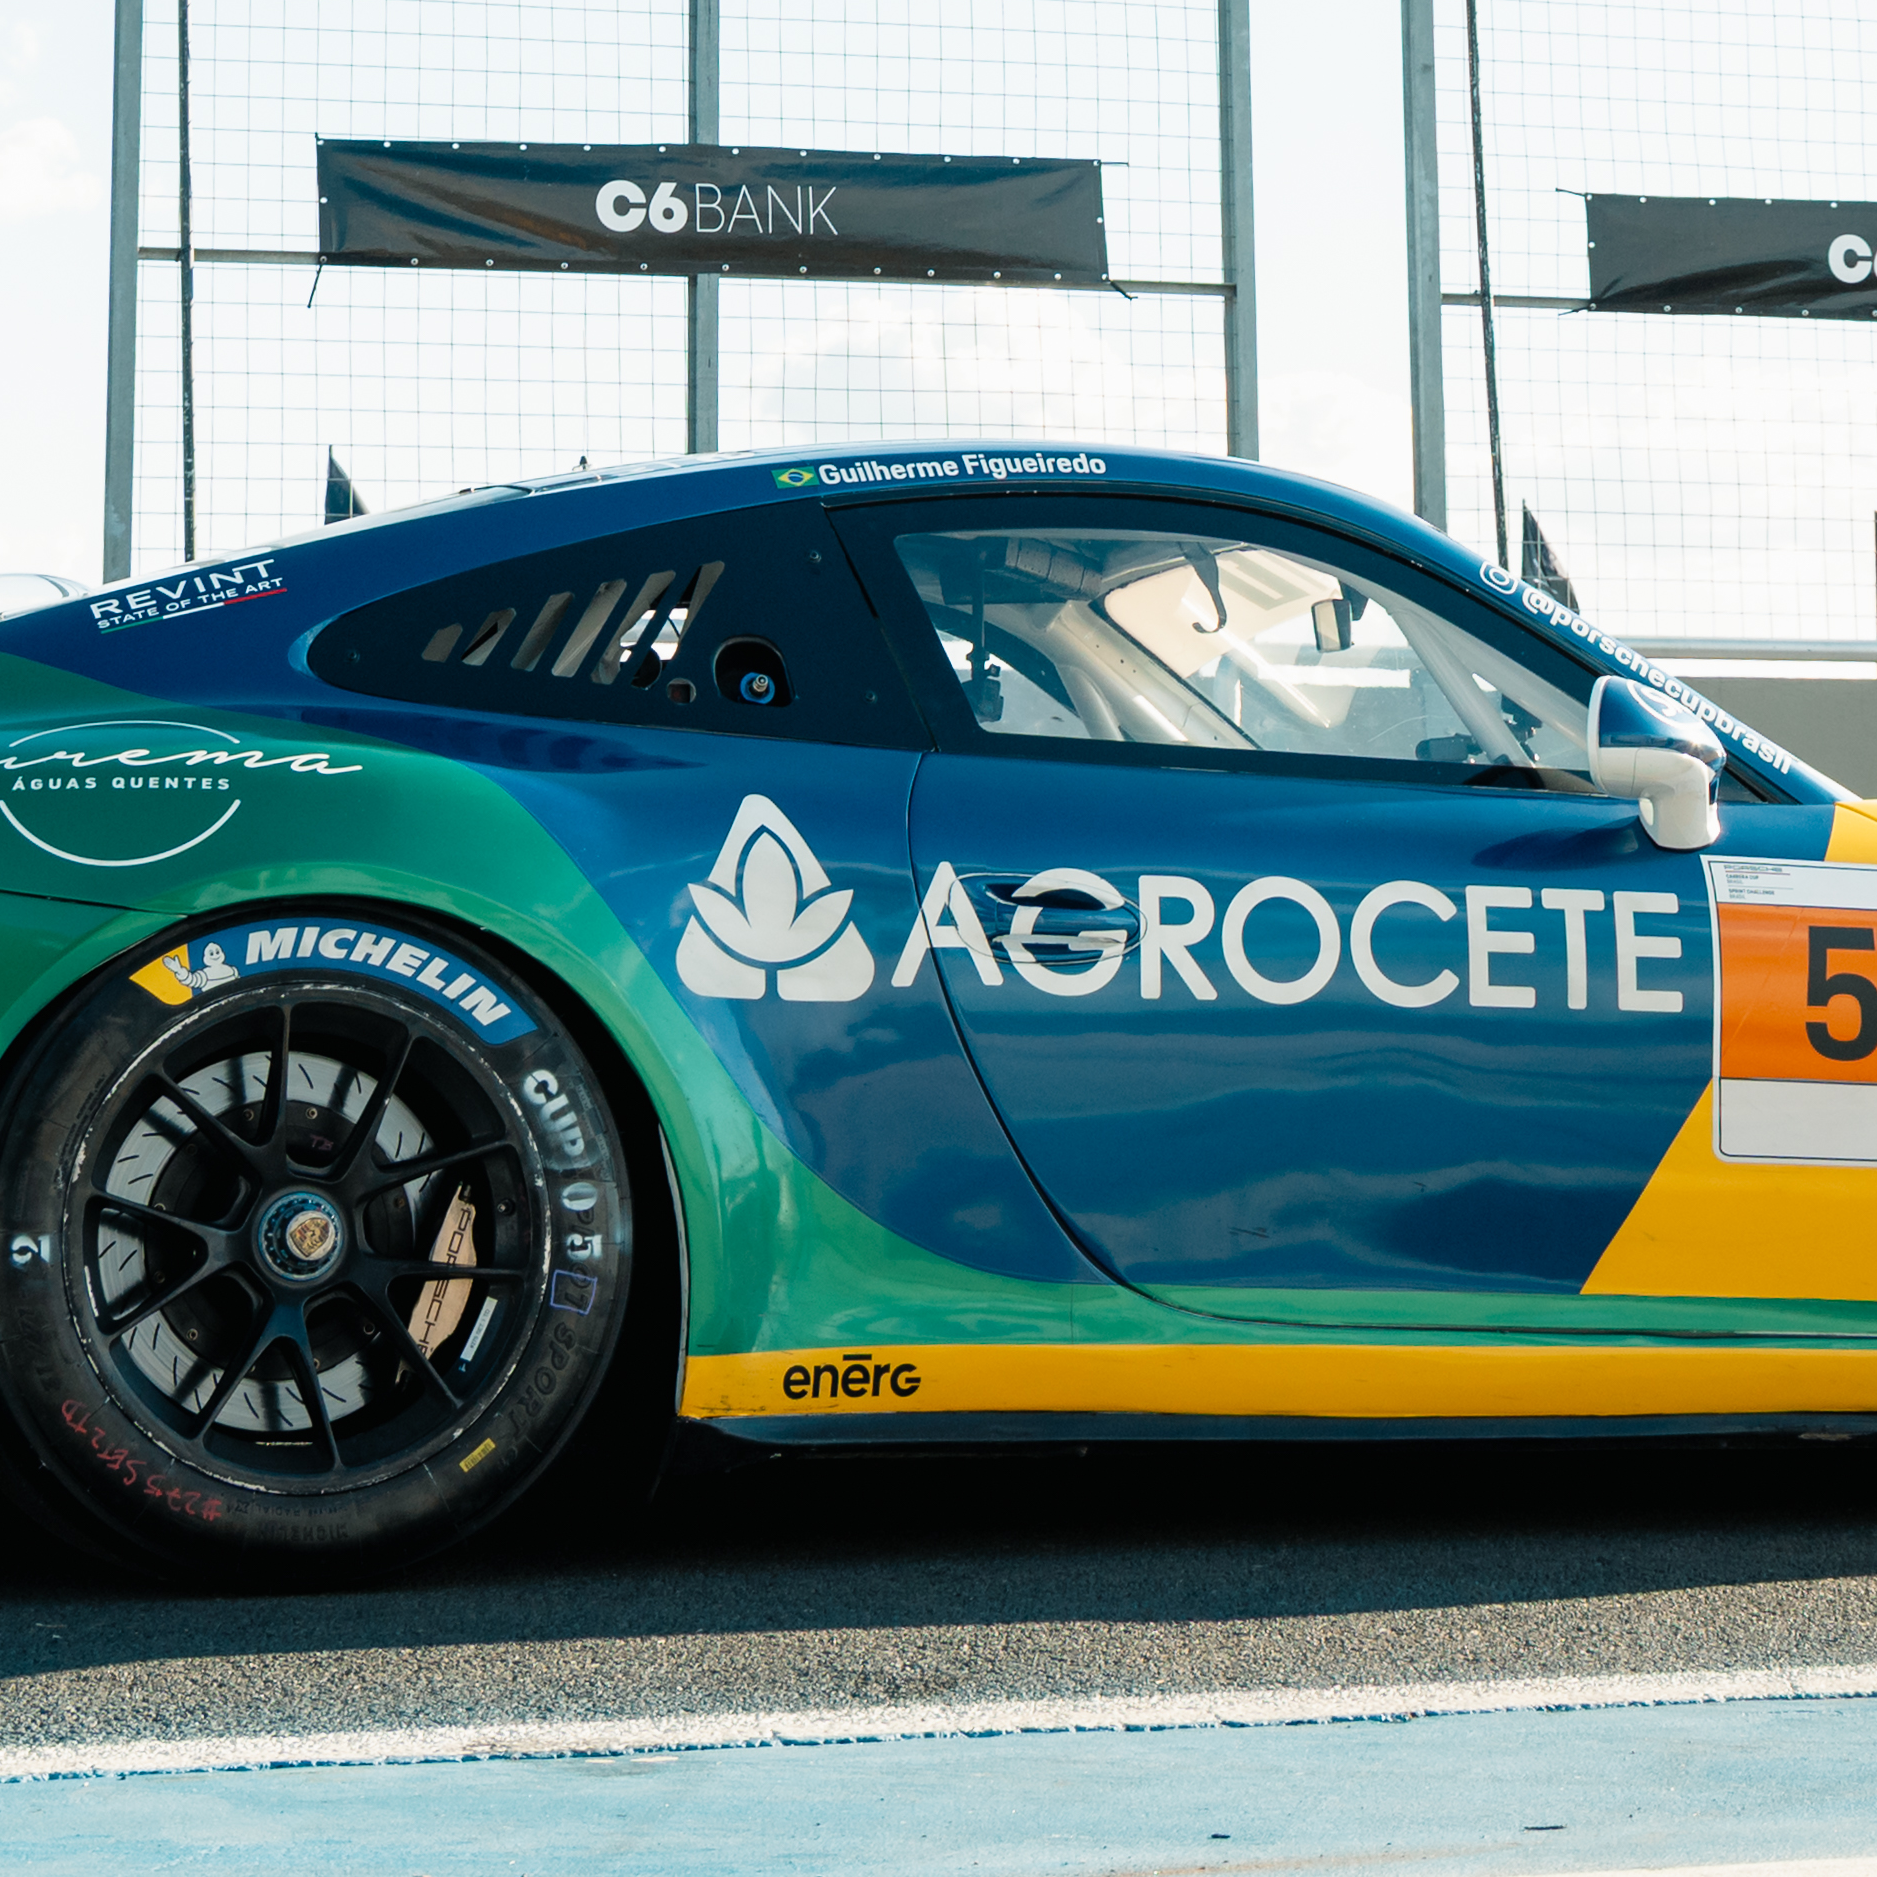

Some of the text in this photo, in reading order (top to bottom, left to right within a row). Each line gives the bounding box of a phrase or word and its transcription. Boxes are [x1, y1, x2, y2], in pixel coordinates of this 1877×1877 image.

[818, 451, 1107, 486] Guilherme Figueiredo
[89, 558, 275, 619] REVINT
[97, 577, 283, 629] STATE OF THE ART
[1521, 586, 1793, 775] @porschecupbrasil
[12, 774, 231, 791] ÁGUAS QUENTES
[890, 859, 1685, 1013] AGROCETE
[244, 926, 513, 1027] MICHELIN
[523, 1068, 586, 1158] CUP
